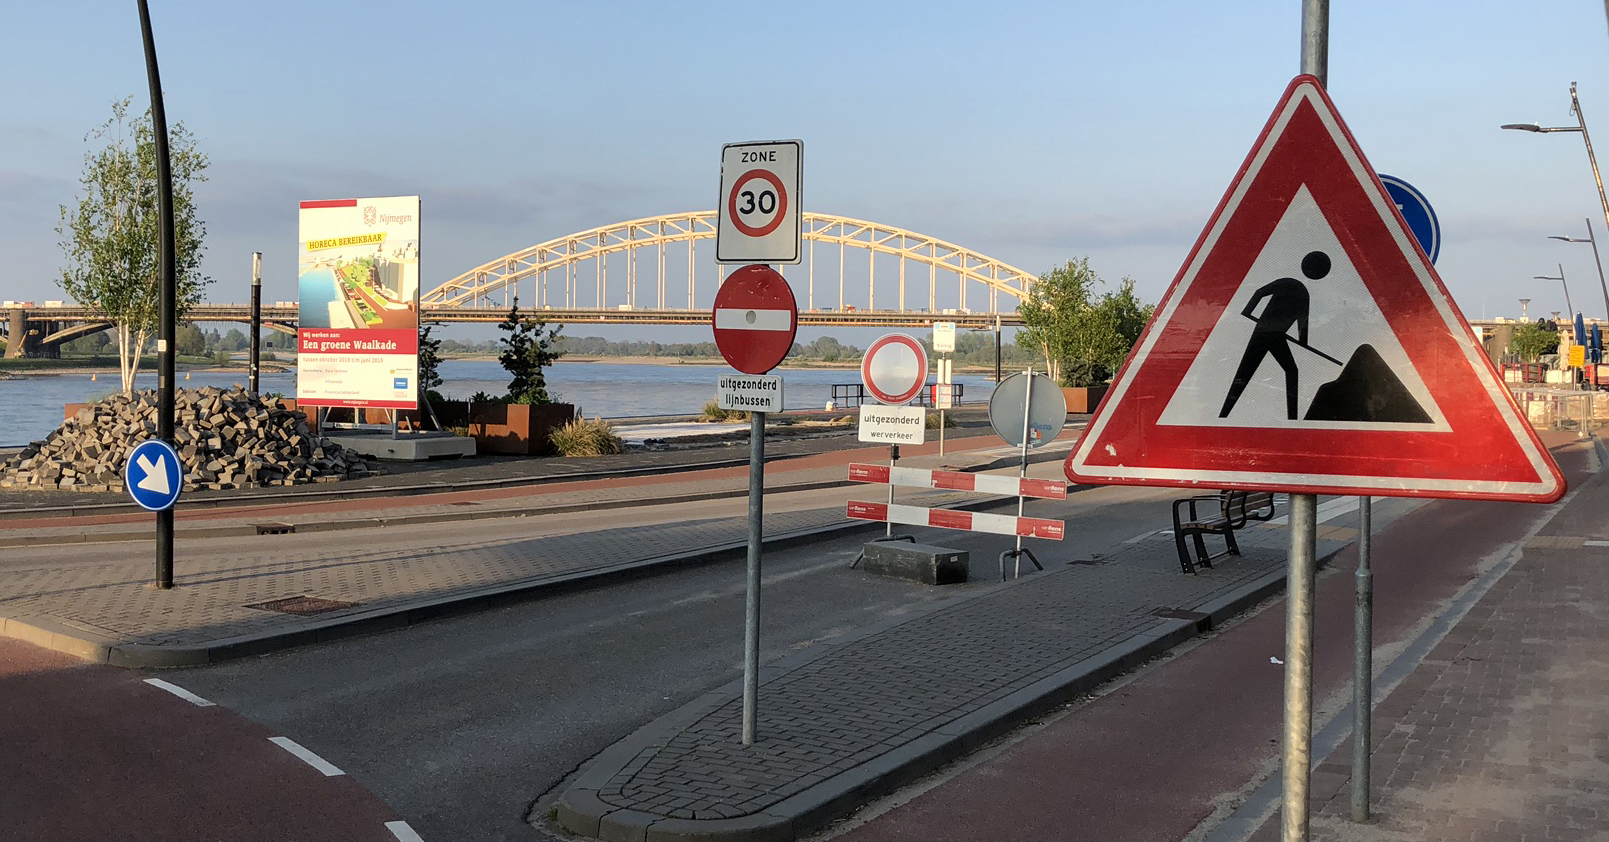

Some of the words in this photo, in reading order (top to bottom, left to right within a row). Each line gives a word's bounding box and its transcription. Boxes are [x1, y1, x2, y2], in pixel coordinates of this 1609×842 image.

[741, 151, 776, 163] ZONE
[739, 190, 776, 214] 30
[379, 214, 412, 225] Nijmegen
[309, 239, 337, 249] HORECA
[338, 233, 382, 246] BEREIKBAAR
[303, 340, 318, 349] Een
[320, 341, 351, 351] groene
[353, 340, 397, 350] Waalkade
[720, 378, 777, 391] uitgezonderd
[725, 393, 771, 407] lijnbussen
[864, 414, 920, 425] uitgezonderd
